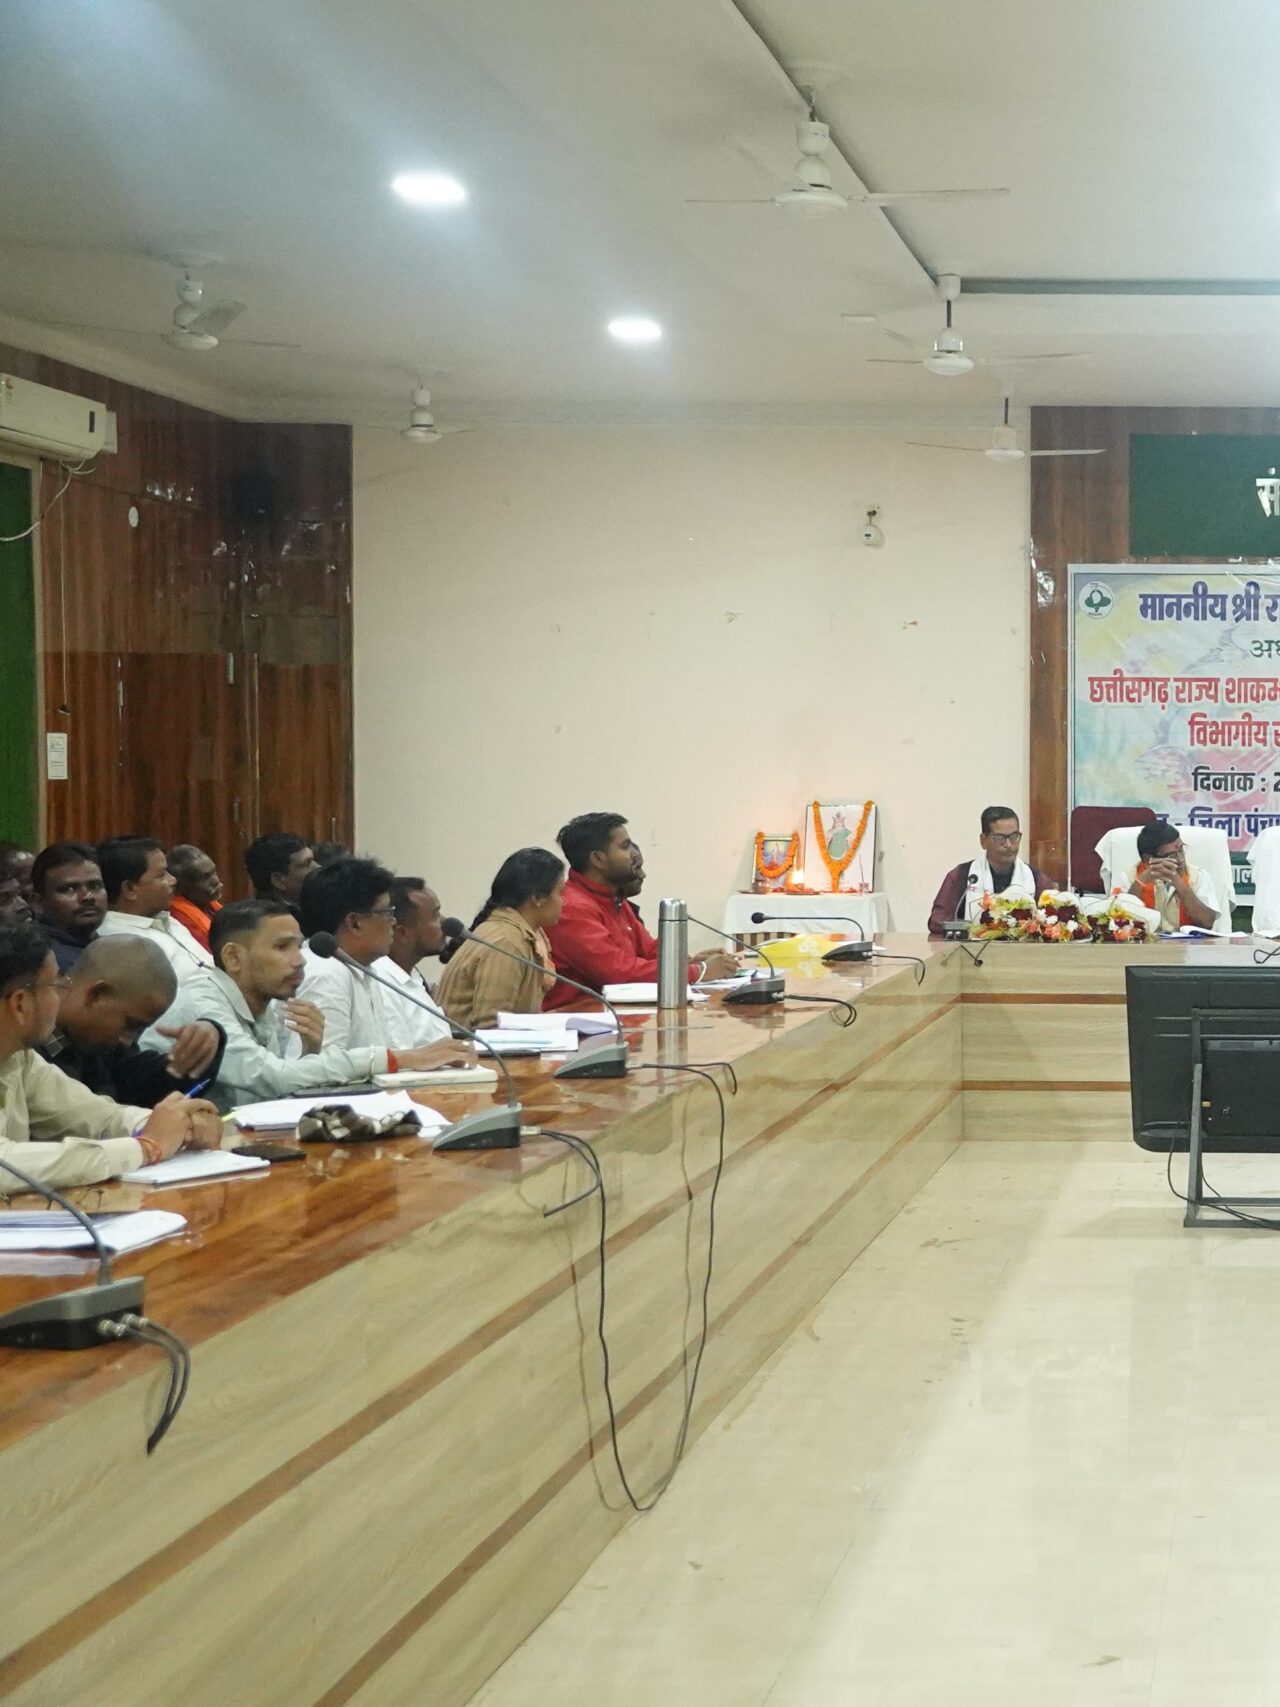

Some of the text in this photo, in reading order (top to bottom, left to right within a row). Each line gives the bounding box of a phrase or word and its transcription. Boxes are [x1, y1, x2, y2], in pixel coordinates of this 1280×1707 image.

[1138, 580, 1228, 621] माननीय
[1231, 580, 1261, 623] श्री
[1088, 668, 1171, 711] छत्तीसगढ़
[1173, 676, 1221, 704] राज्य
[1188, 712, 1270, 747] विभागीय
[1191, 766, 1256, 792] दिनांक
